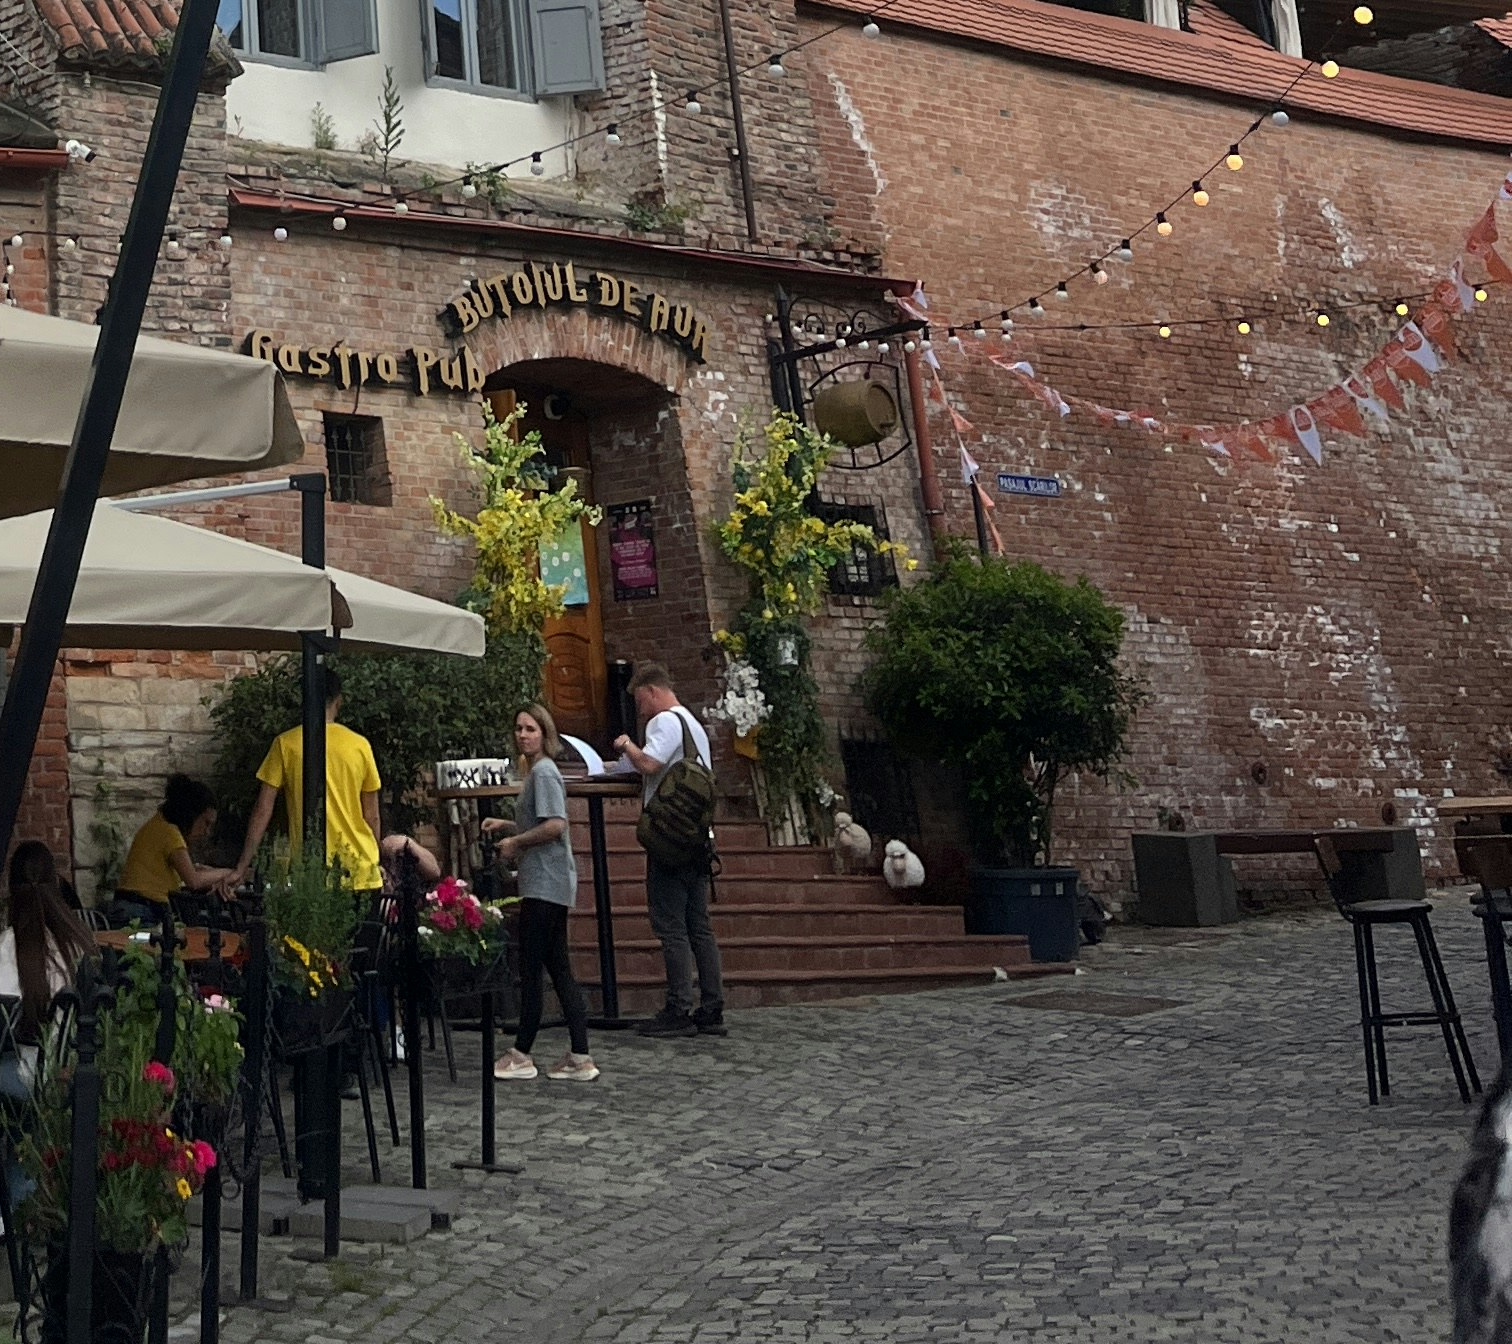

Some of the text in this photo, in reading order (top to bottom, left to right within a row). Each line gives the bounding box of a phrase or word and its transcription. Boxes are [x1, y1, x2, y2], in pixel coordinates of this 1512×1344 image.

[452, 260, 714, 362] BUTOIUL DE AUR
[251, 329, 486, 397] Gastro Pub
